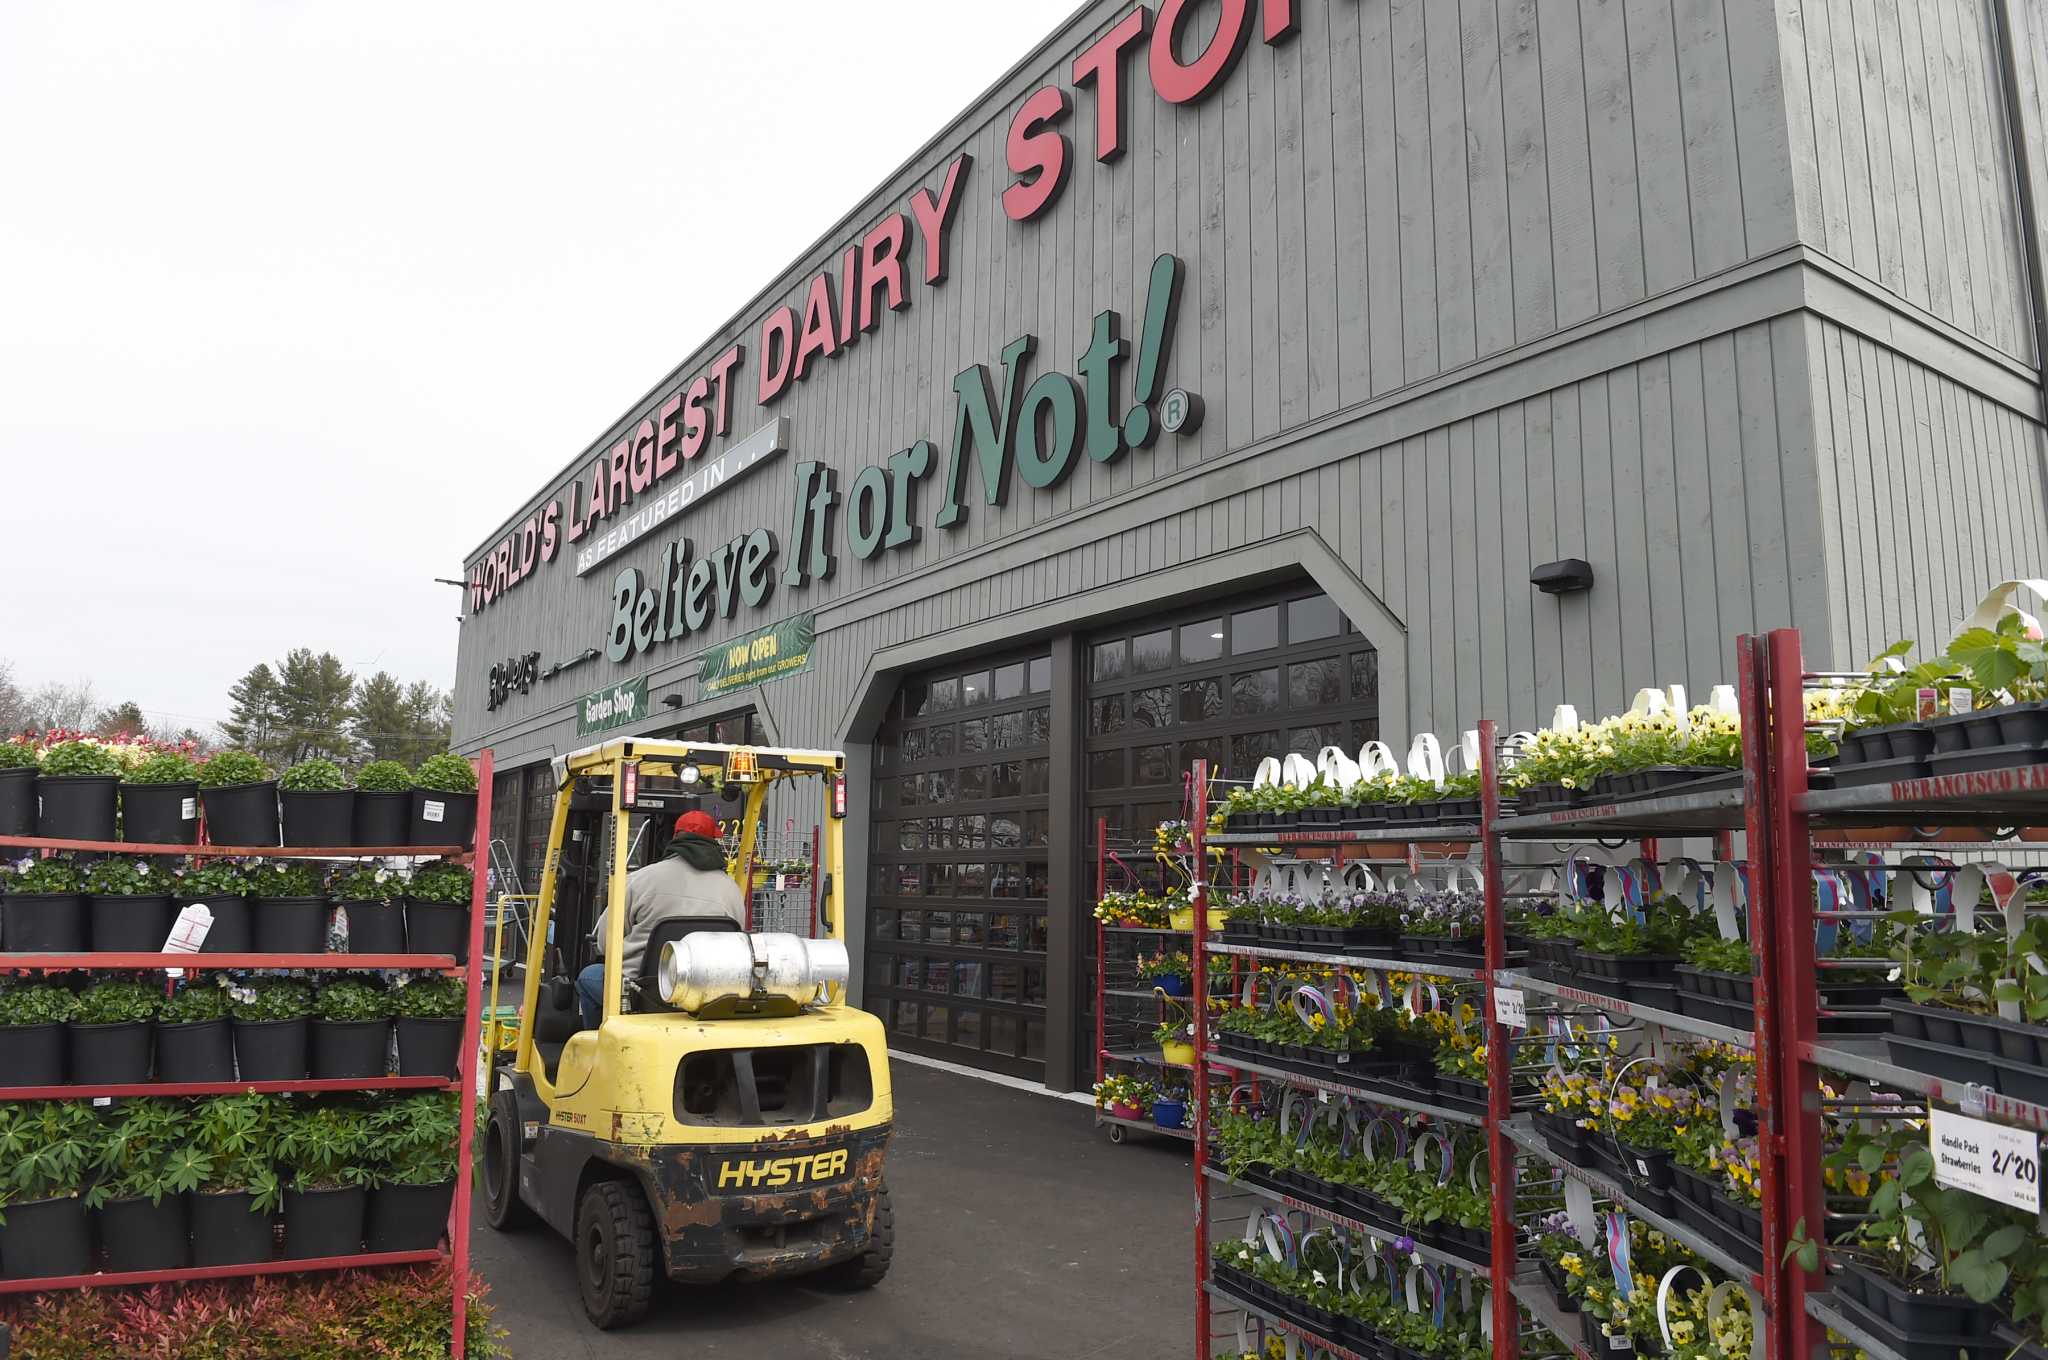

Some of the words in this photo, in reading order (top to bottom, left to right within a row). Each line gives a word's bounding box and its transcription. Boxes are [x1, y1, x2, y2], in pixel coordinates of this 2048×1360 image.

[471, 500, 562, 615] WORLD'S
[568, 344, 745, 544] LARGEST
[759, 153, 973, 405] DAIRY
[606, 528, 778, 662] Believe
[782, 461, 840, 587] It
[847, 440, 938, 560] or
[936, 253, 1186, 529] Not!
[577, 548, 593, 574] AS
[597, 481, 694, 557] FEATURED
[703, 458, 725, 492] IN
[729, 643, 750, 670] NOW
[751, 633, 777, 661] OPEN
[768, 664, 776, 675] our
[586, 697, 613, 724] Garden
[613, 687, 635, 717] Shop
[1891, 769, 2012, 801] DEFRANCESCO
[1941, 1133, 1963, 1151] Handle
[1963, 1139, 1980, 1154] Pack
[718, 1149, 849, 1188] HYSTER
[1941, 1152, 1982, 1175] Strawberries
